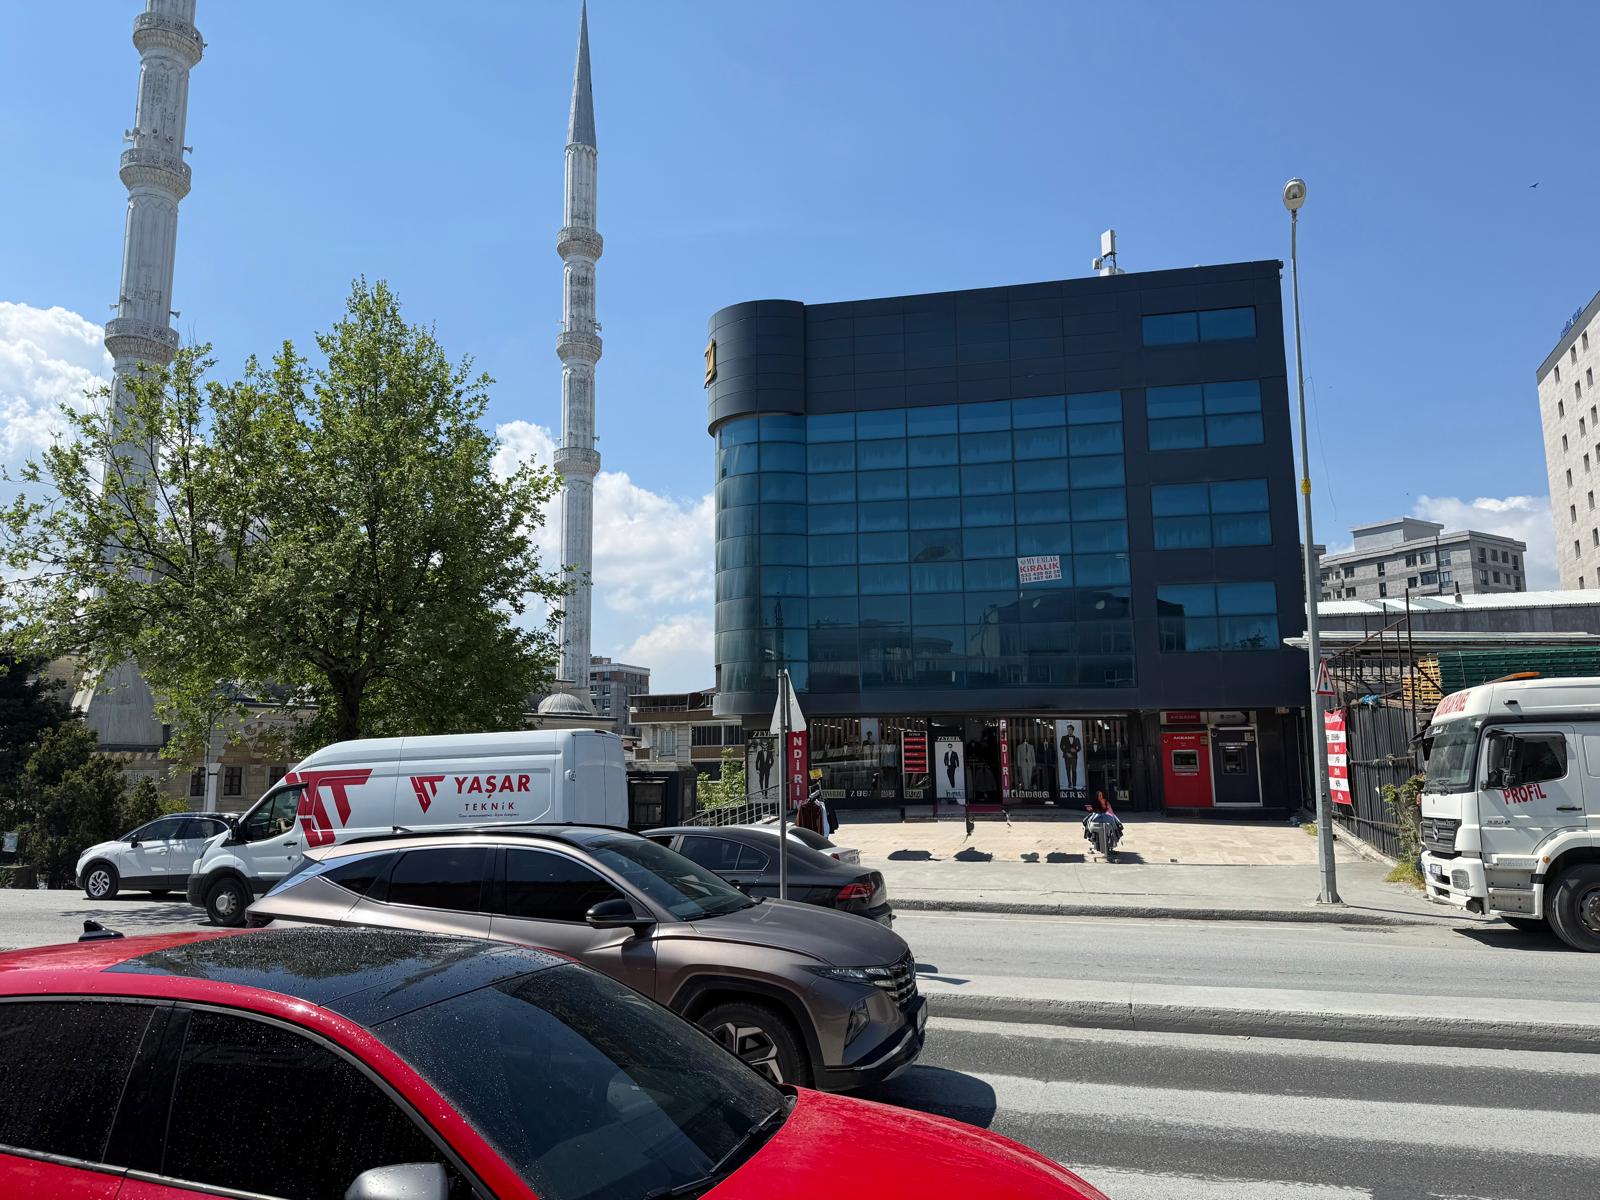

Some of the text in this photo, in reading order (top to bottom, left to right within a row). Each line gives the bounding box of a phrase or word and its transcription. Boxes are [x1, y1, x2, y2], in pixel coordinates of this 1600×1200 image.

[1020, 562, 1059, 573] KIRALIK
[454, 774, 530, 799] YAŞAR
[465, 802, 514, 811] TEKNİK
